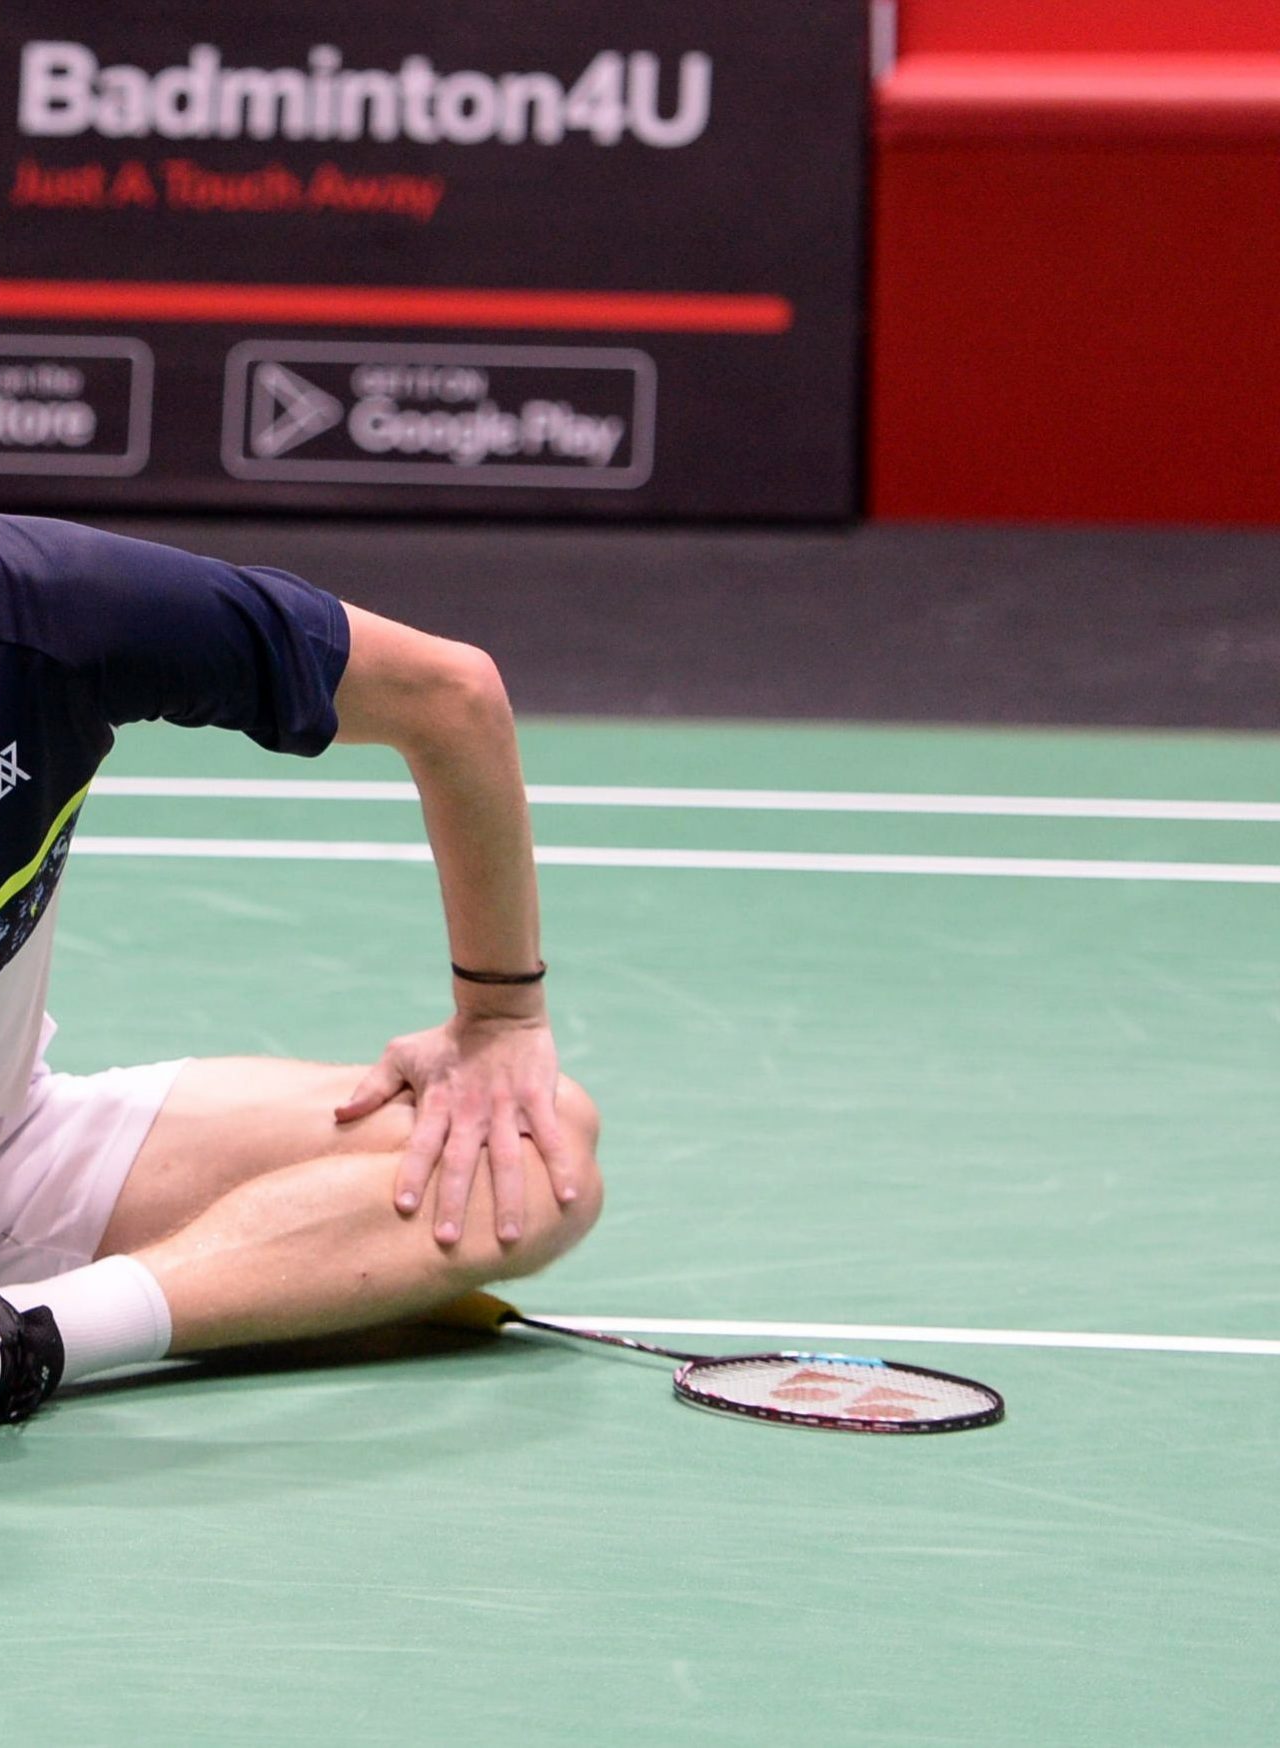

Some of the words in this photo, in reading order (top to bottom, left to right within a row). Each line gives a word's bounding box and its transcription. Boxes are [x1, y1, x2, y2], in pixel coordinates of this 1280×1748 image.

[20, 42, 710, 147] Badminton4U
[13, 160, 106, 206] Just
[114, 161, 154, 206] A
[164, 159, 302, 211] Touch
[308, 163, 442, 220] Away
[348, 398, 520, 466] Google
[522, 401, 623, 466] Play
